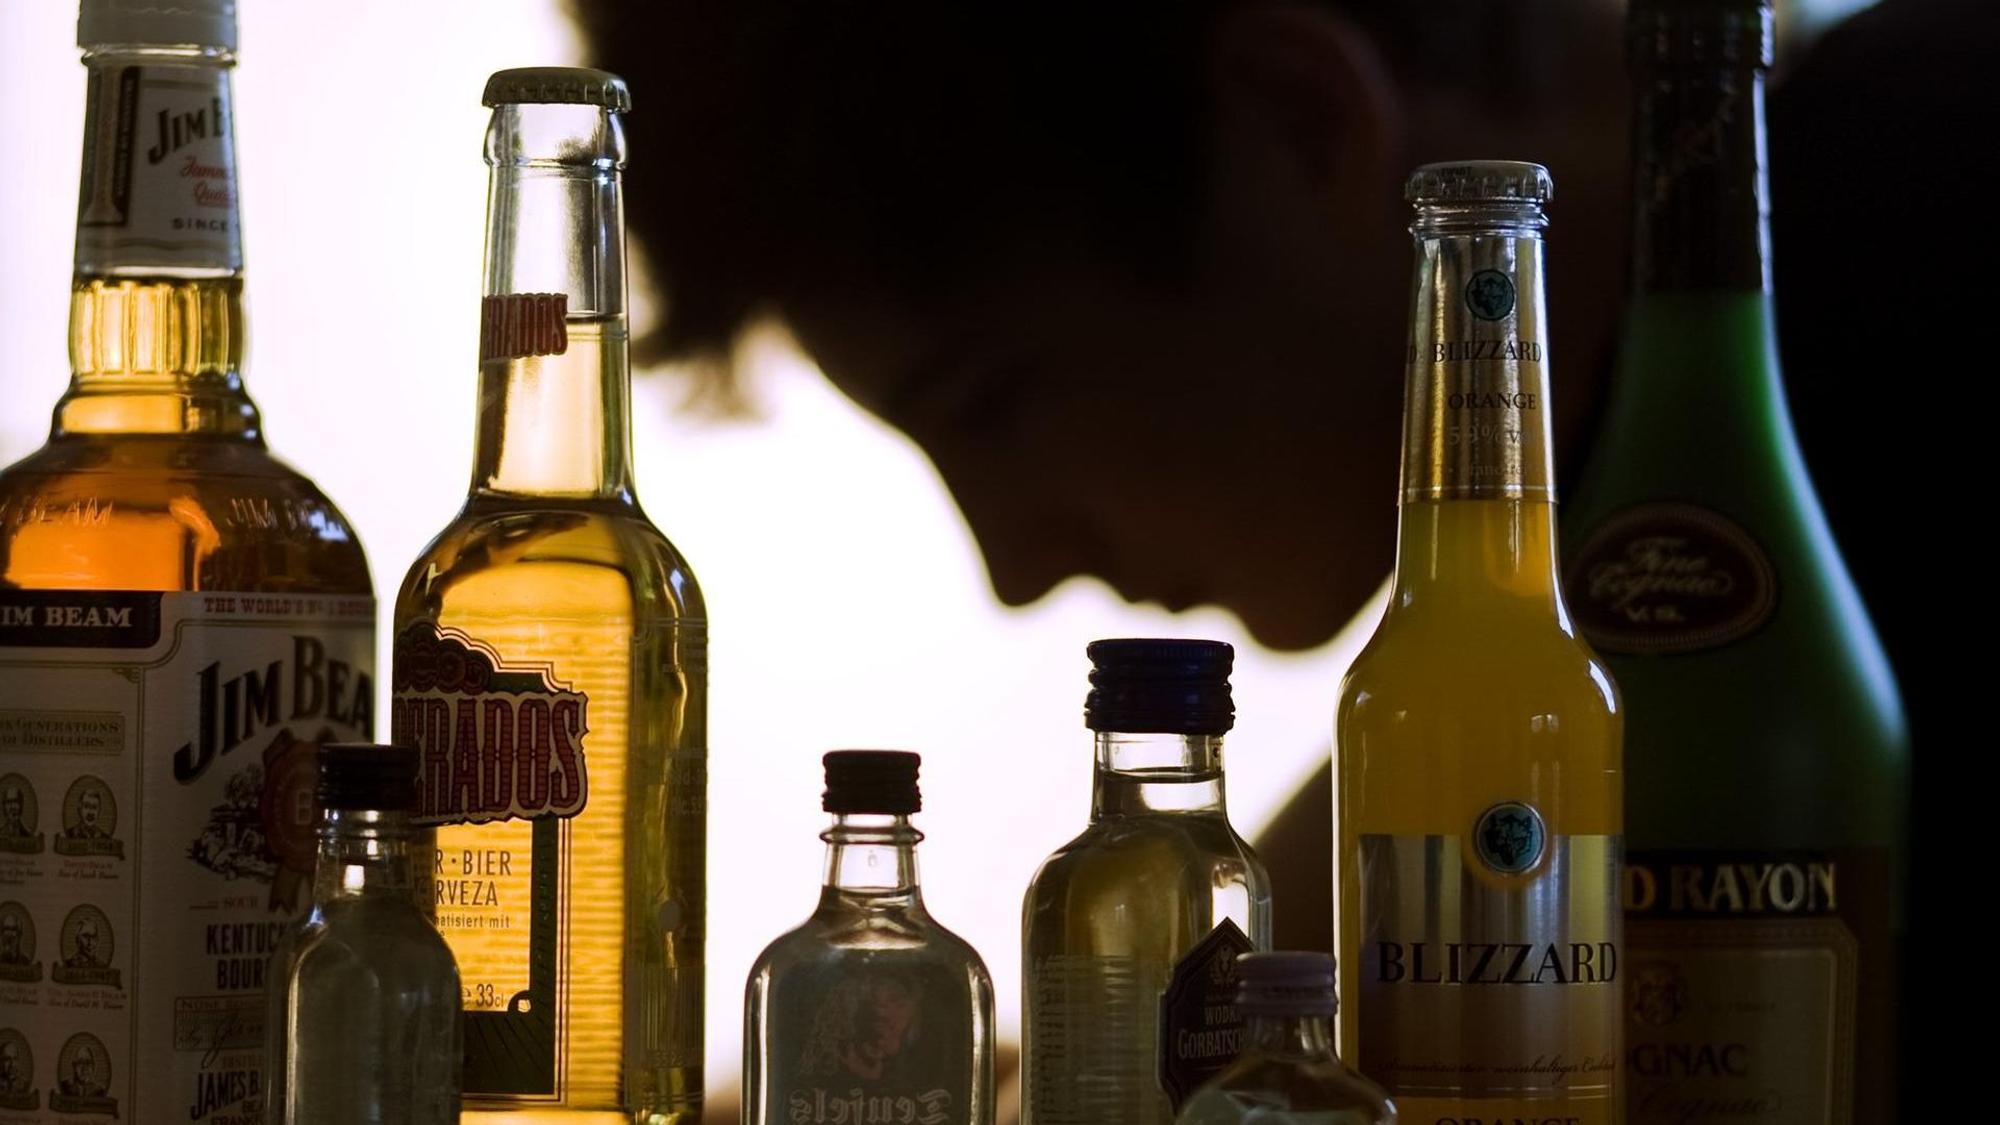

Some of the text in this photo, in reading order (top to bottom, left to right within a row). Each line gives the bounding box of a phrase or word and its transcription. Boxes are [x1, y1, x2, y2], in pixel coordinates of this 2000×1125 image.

[148, 107, 207, 166] JIM
[1433, 340, 1542, 363] BLIZZARD
[1448, 393, 1537, 410] ORANGE
[0, 605, 132, 627] IM BEAM
[204, 597, 236, 613] THE
[174, 660, 284, 785] JIM
[463, 850, 511, 876] BIER
[1668, 861, 1837, 912] RAYON
[489, 915, 510, 928] mit
[1377, 941, 1617, 984] BLIZZARD
[1626, 1042, 1748, 1078] GNAC
[190, 1070, 246, 1121] JAMES
